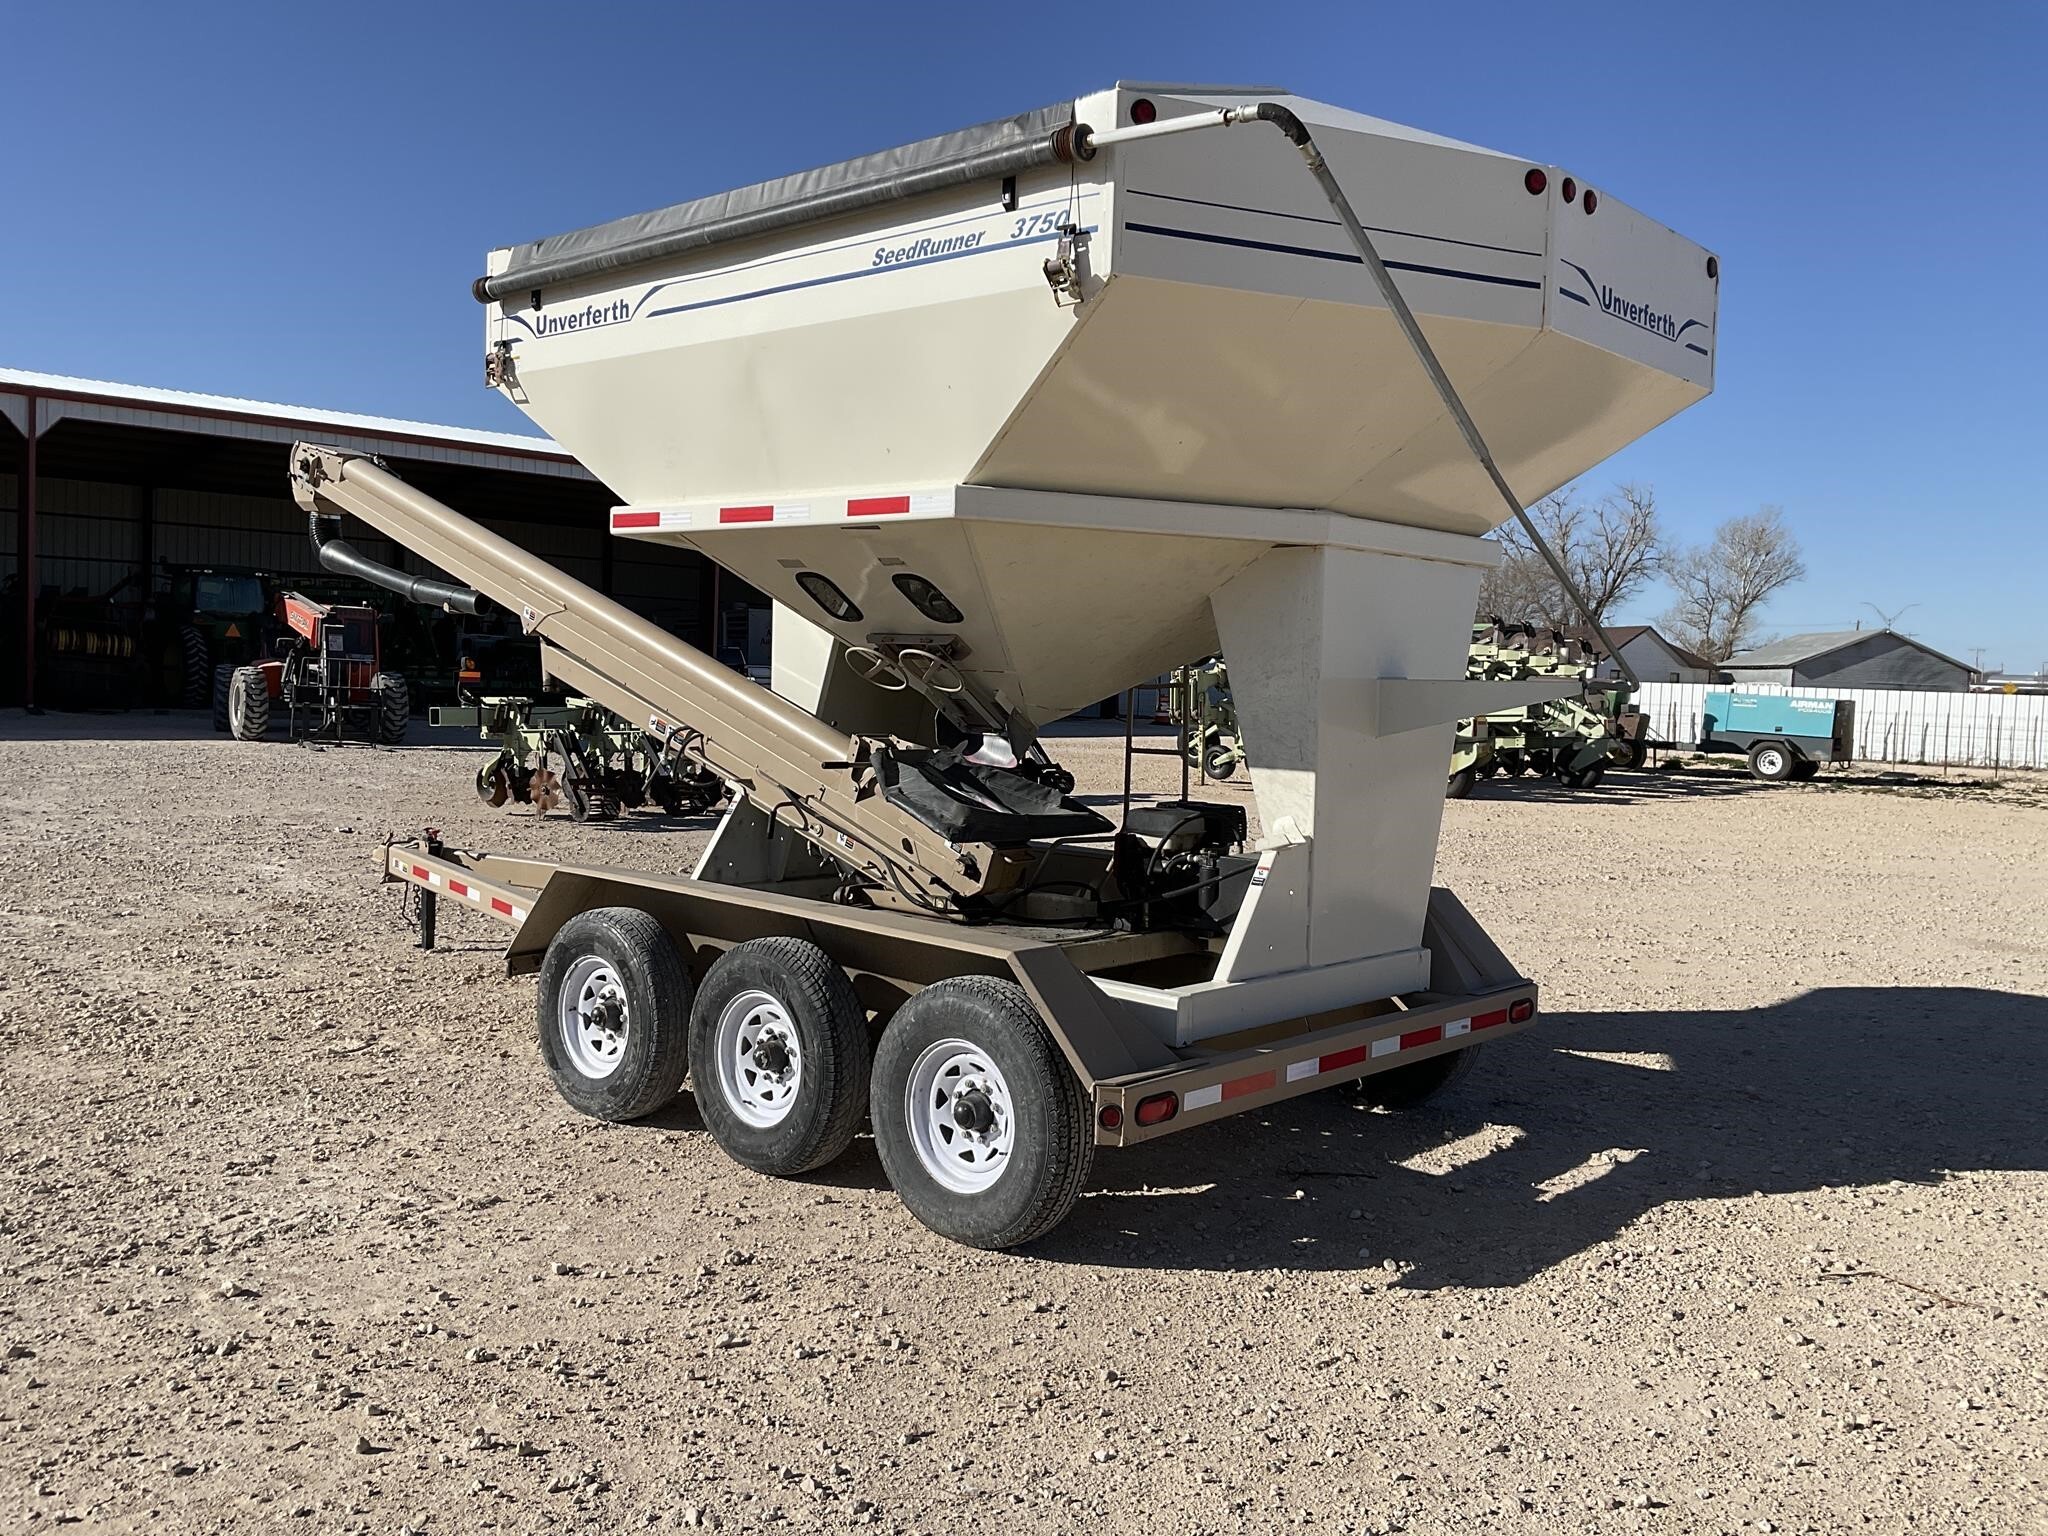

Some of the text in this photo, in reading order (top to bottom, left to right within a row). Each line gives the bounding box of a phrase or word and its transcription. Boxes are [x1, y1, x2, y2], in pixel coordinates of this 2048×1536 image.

[872, 230, 986, 267] SeedRunner
[535, 298, 630, 336] Unverferth
[1602, 285, 1675, 338] Unverferth
[1790, 700, 1833, 710] AIRMAN
